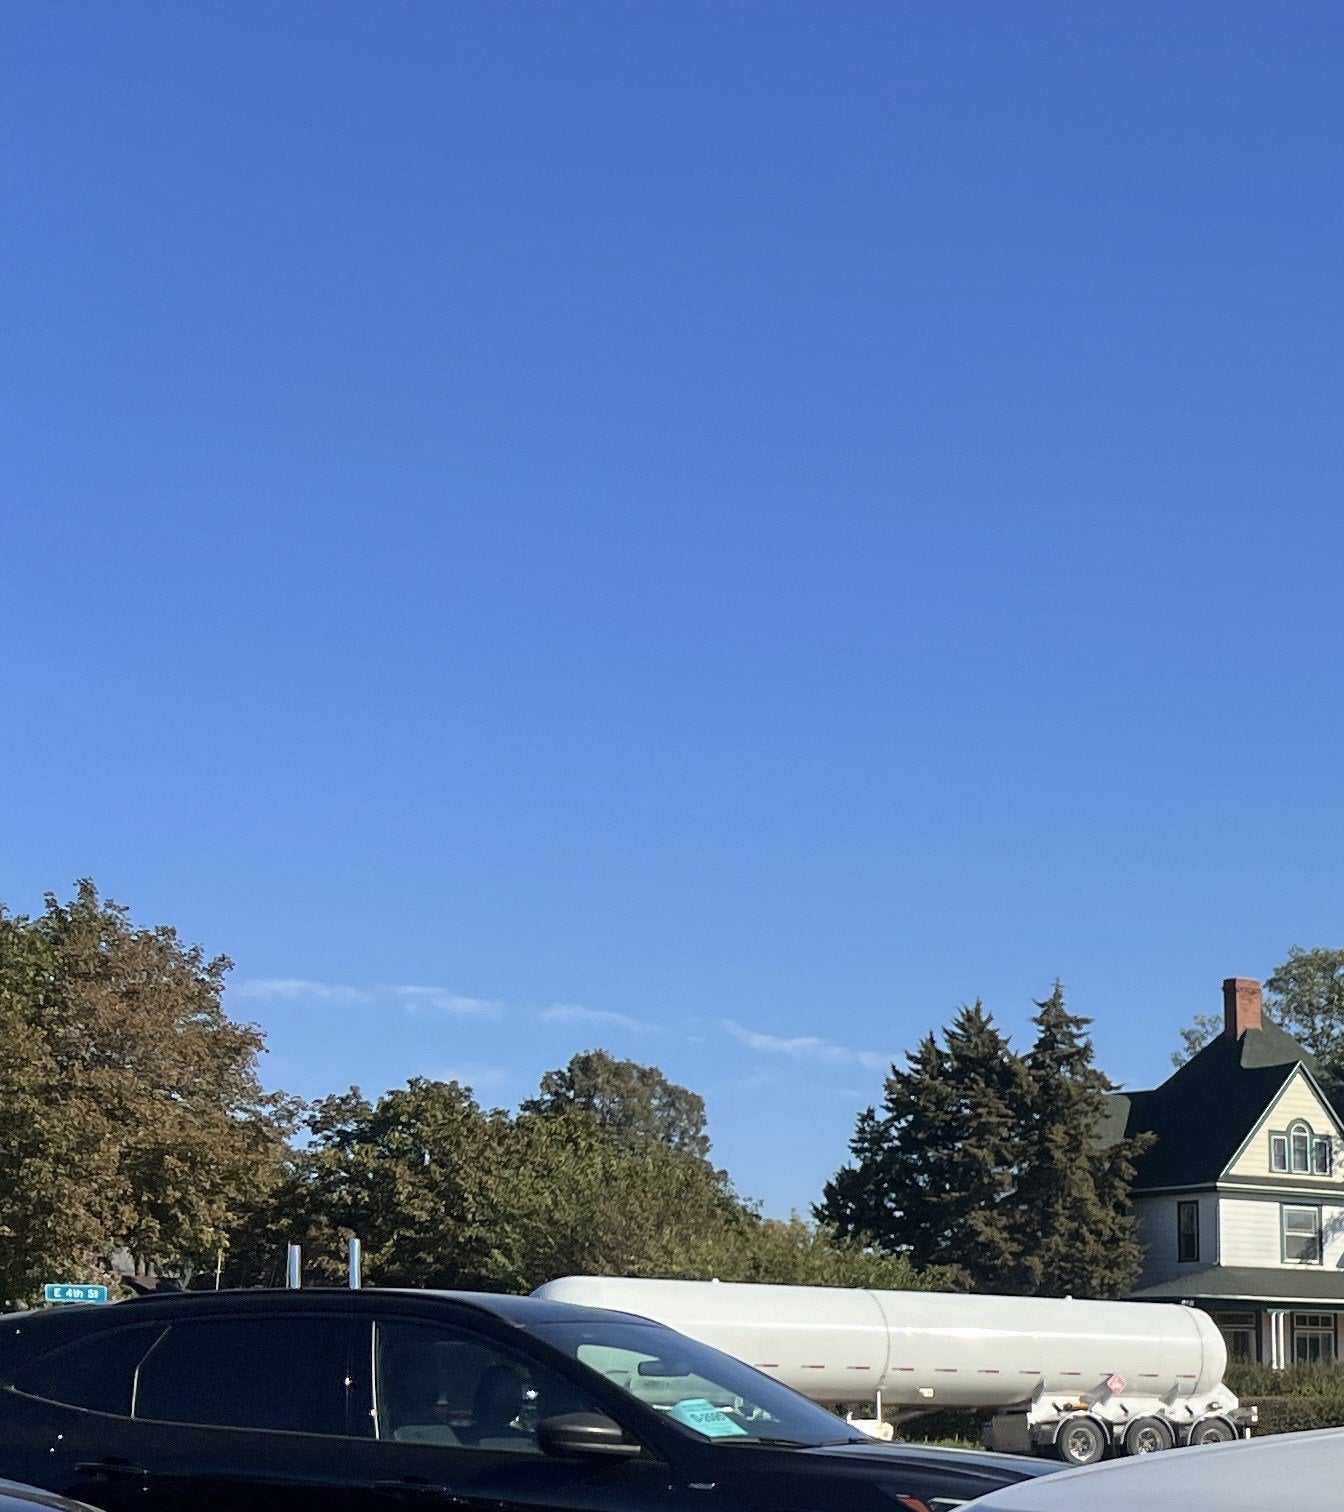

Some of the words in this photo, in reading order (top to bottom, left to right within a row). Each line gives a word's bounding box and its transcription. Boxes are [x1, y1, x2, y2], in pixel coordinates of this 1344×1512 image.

[53, 1287, 62, 1298] E
[65, 1288, 84, 1298] 4th
[87, 1288, 99, 1299] St
